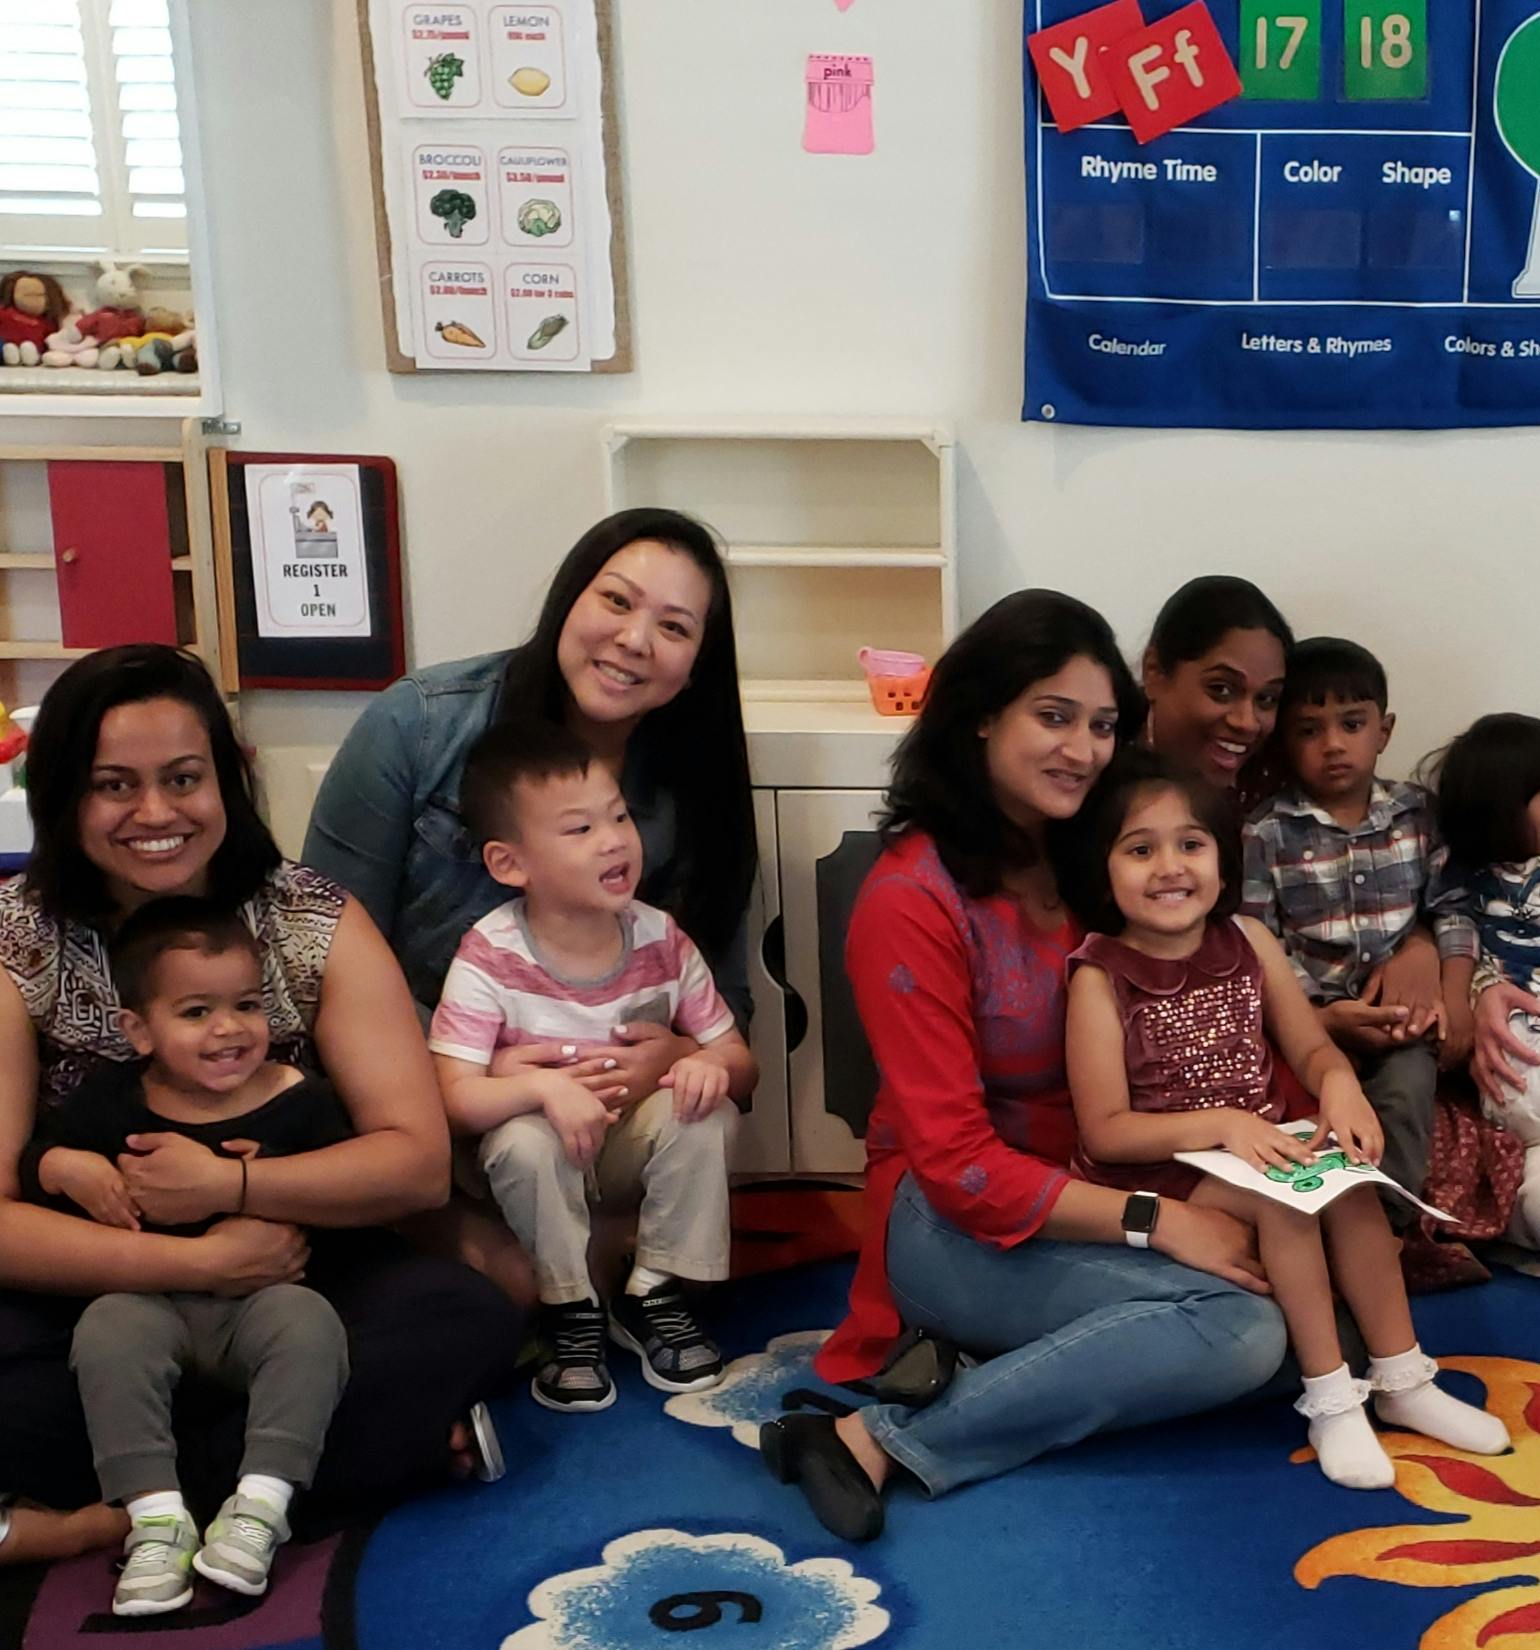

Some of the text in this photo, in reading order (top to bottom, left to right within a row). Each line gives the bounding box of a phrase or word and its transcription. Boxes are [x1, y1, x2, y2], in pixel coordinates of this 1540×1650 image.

[412, 14, 463, 26] GRAPES
[503, 15, 549, 27] LEMON
[1254, 15, 1309, 71] 17
[1360, 13, 1413, 70] 18
[823, 63, 852, 81] pink
[1127, 29, 1205, 112] Ff
[418, 154, 482, 166] BROCCOLI
[500, 156, 567, 167] CAULIFLOWER
[1081, 155, 1217, 184] Rhyme Time
[1283, 160, 1342, 184] Color
[1382, 162, 1452, 190] Shape
[428, 271, 485, 283] CARROTS
[522, 273, 560, 285] CORN
[1088, 333, 1167, 357] Calendar
[1240, 332, 1392, 358] Letters & Rhymes
[1444, 335, 1497, 357] Colors
[1500, 340, 1516, 357] &
[283, 563, 348, 578] REGISTER
[313, 583, 321, 597] 1
[300, 603, 336, 617] OPEN
